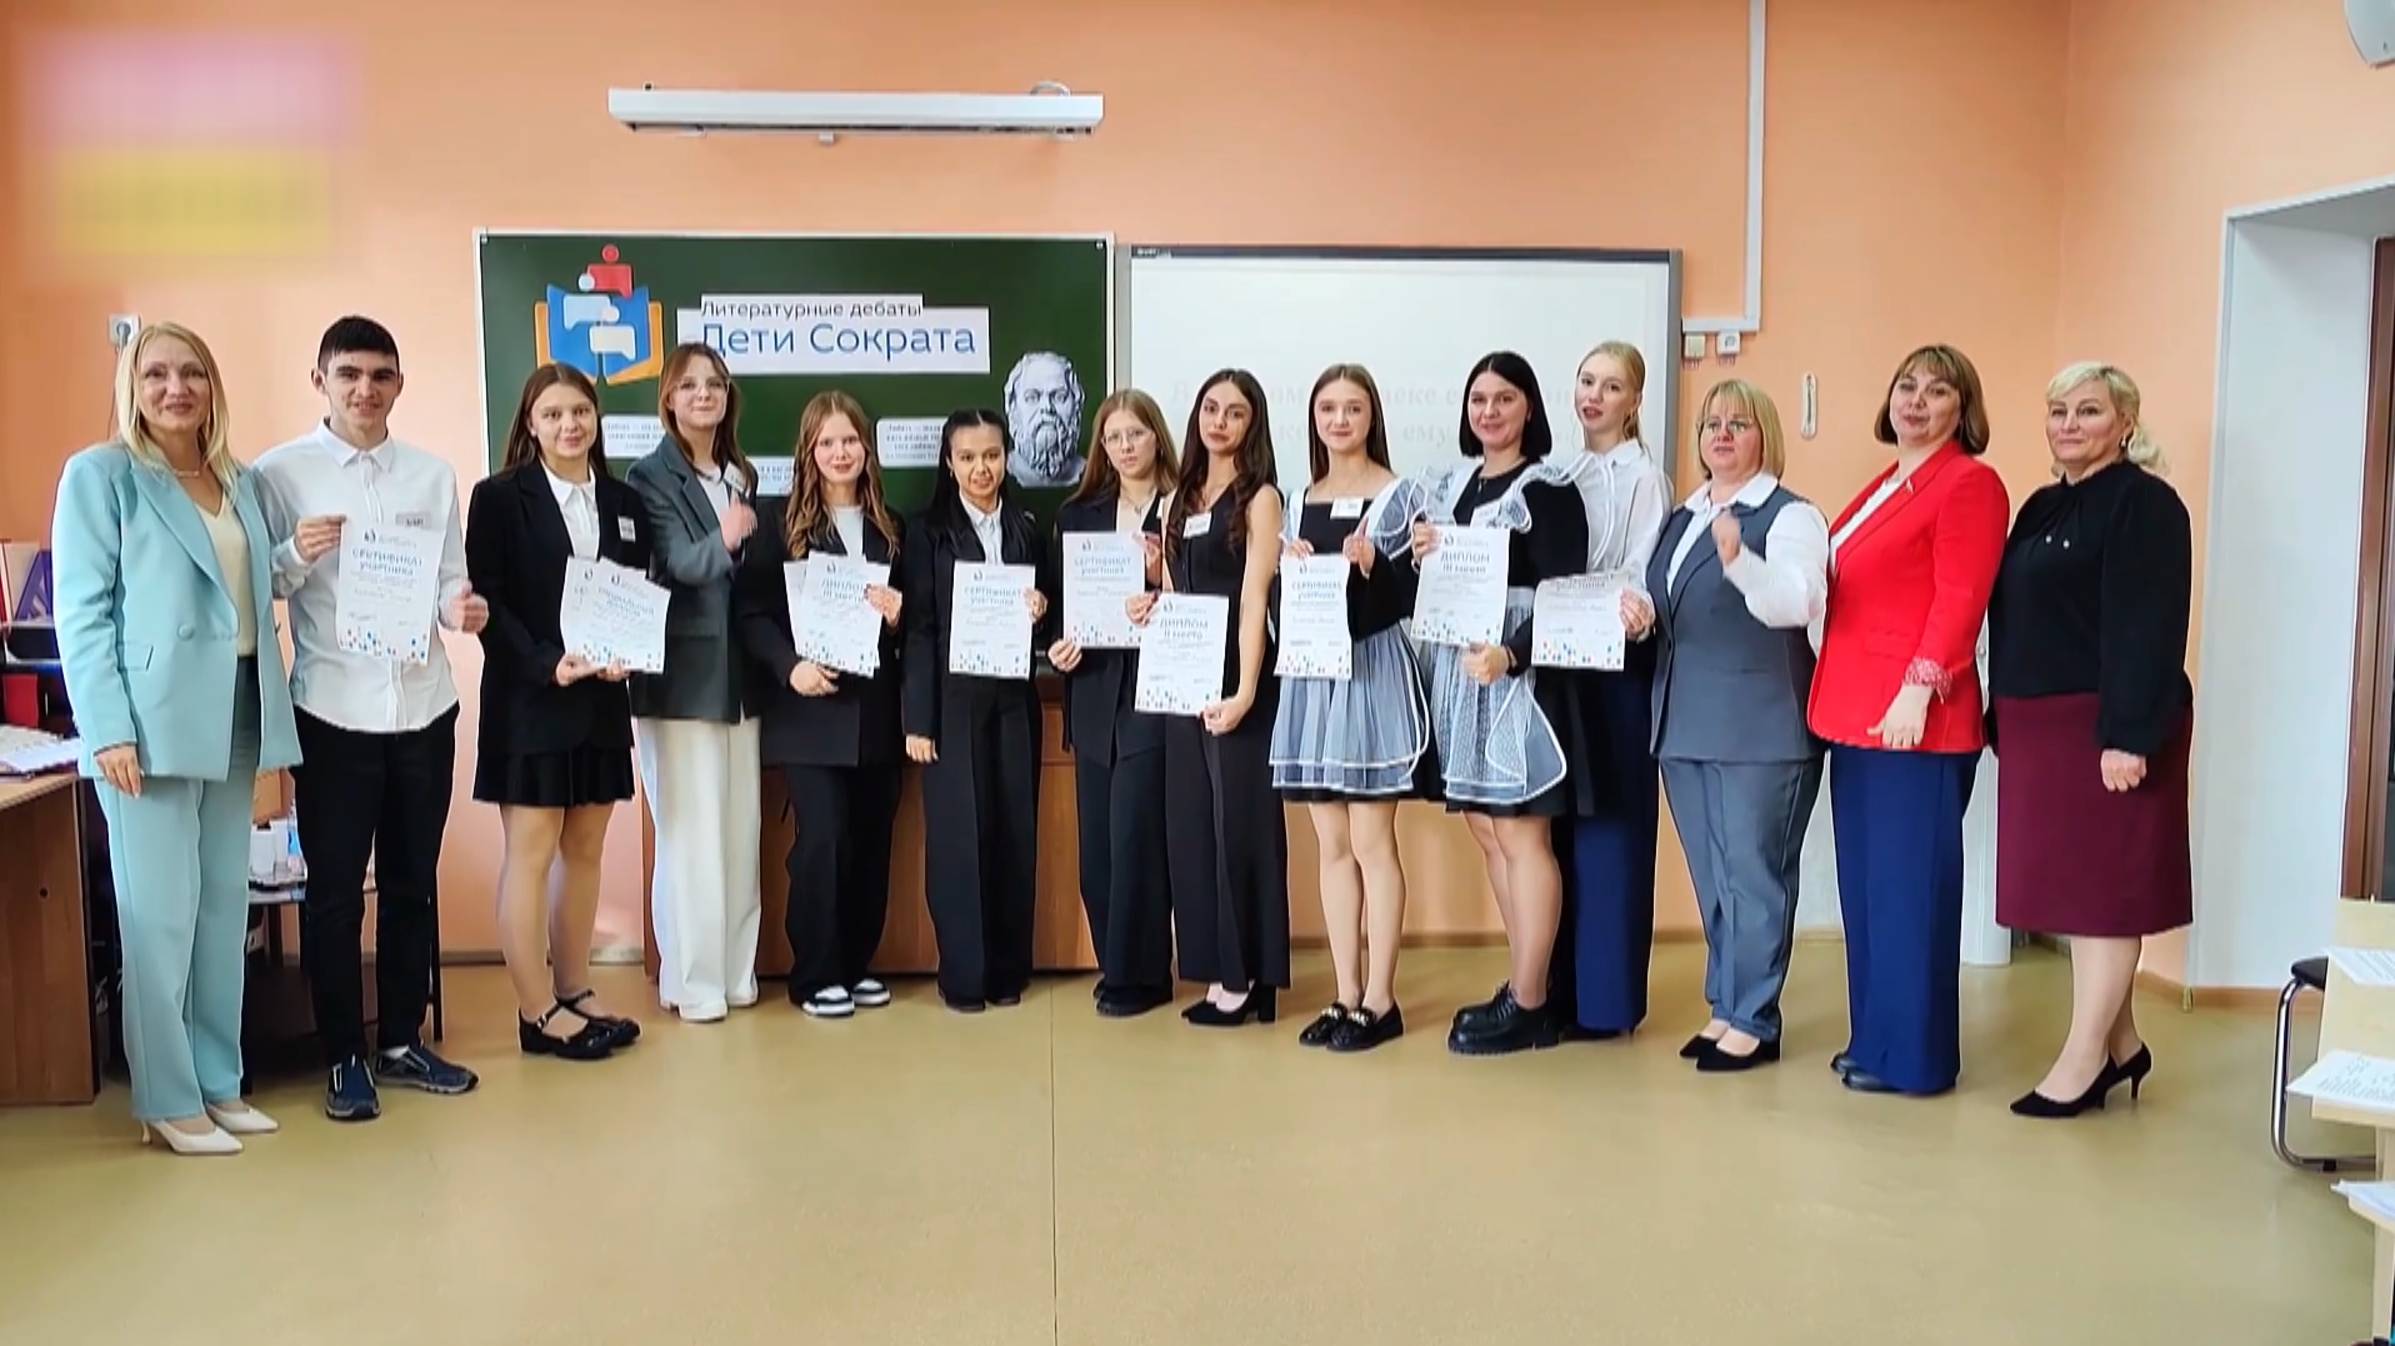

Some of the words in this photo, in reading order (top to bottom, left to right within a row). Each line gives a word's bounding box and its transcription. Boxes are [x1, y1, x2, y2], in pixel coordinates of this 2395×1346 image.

[702, 300, 844, 321] Литературные
[850, 300, 922, 318] дебаты
[702, 323, 795, 357] Дети
[809, 322, 976, 362] Сократа
